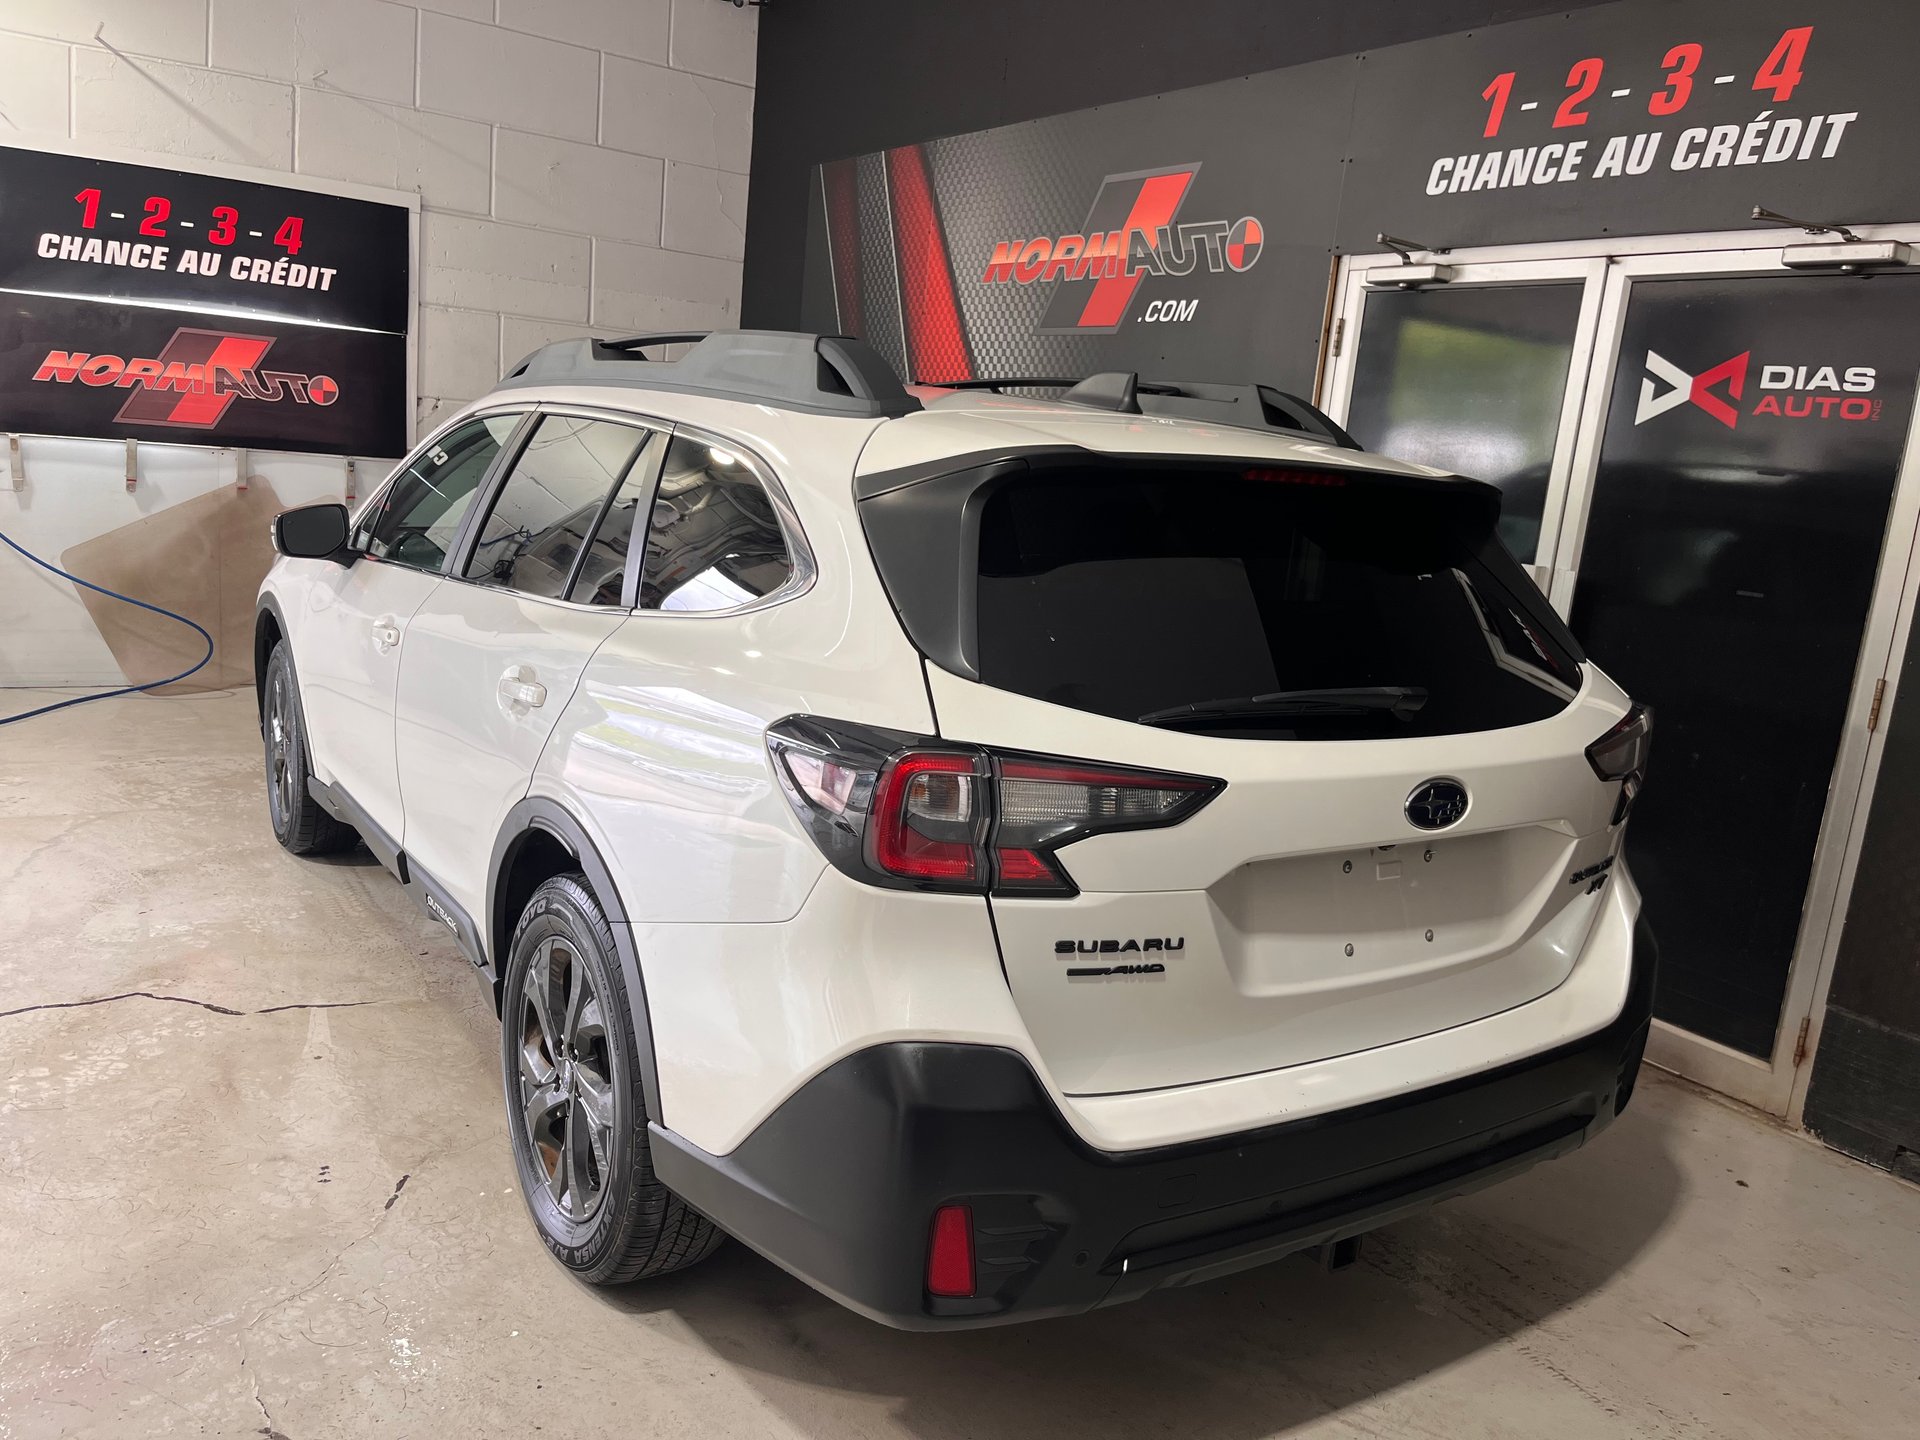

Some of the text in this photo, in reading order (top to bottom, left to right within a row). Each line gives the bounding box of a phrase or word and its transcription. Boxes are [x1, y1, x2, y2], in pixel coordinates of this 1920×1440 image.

[1425, 110, 1859, 196] CHANCE AU CRÉDIT
[37, 233, 337, 291] CHANCE AU CRÉDIT
[1137, 299, 1199, 323] .COM
[1759, 365, 1877, 392] DIAS
[1752, 396, 1872, 420] AUTO
[515, 898, 547, 940] TOYO
[1055, 937, 1184, 953] SUBARU
[1102, 963, 1165, 975] AWD
